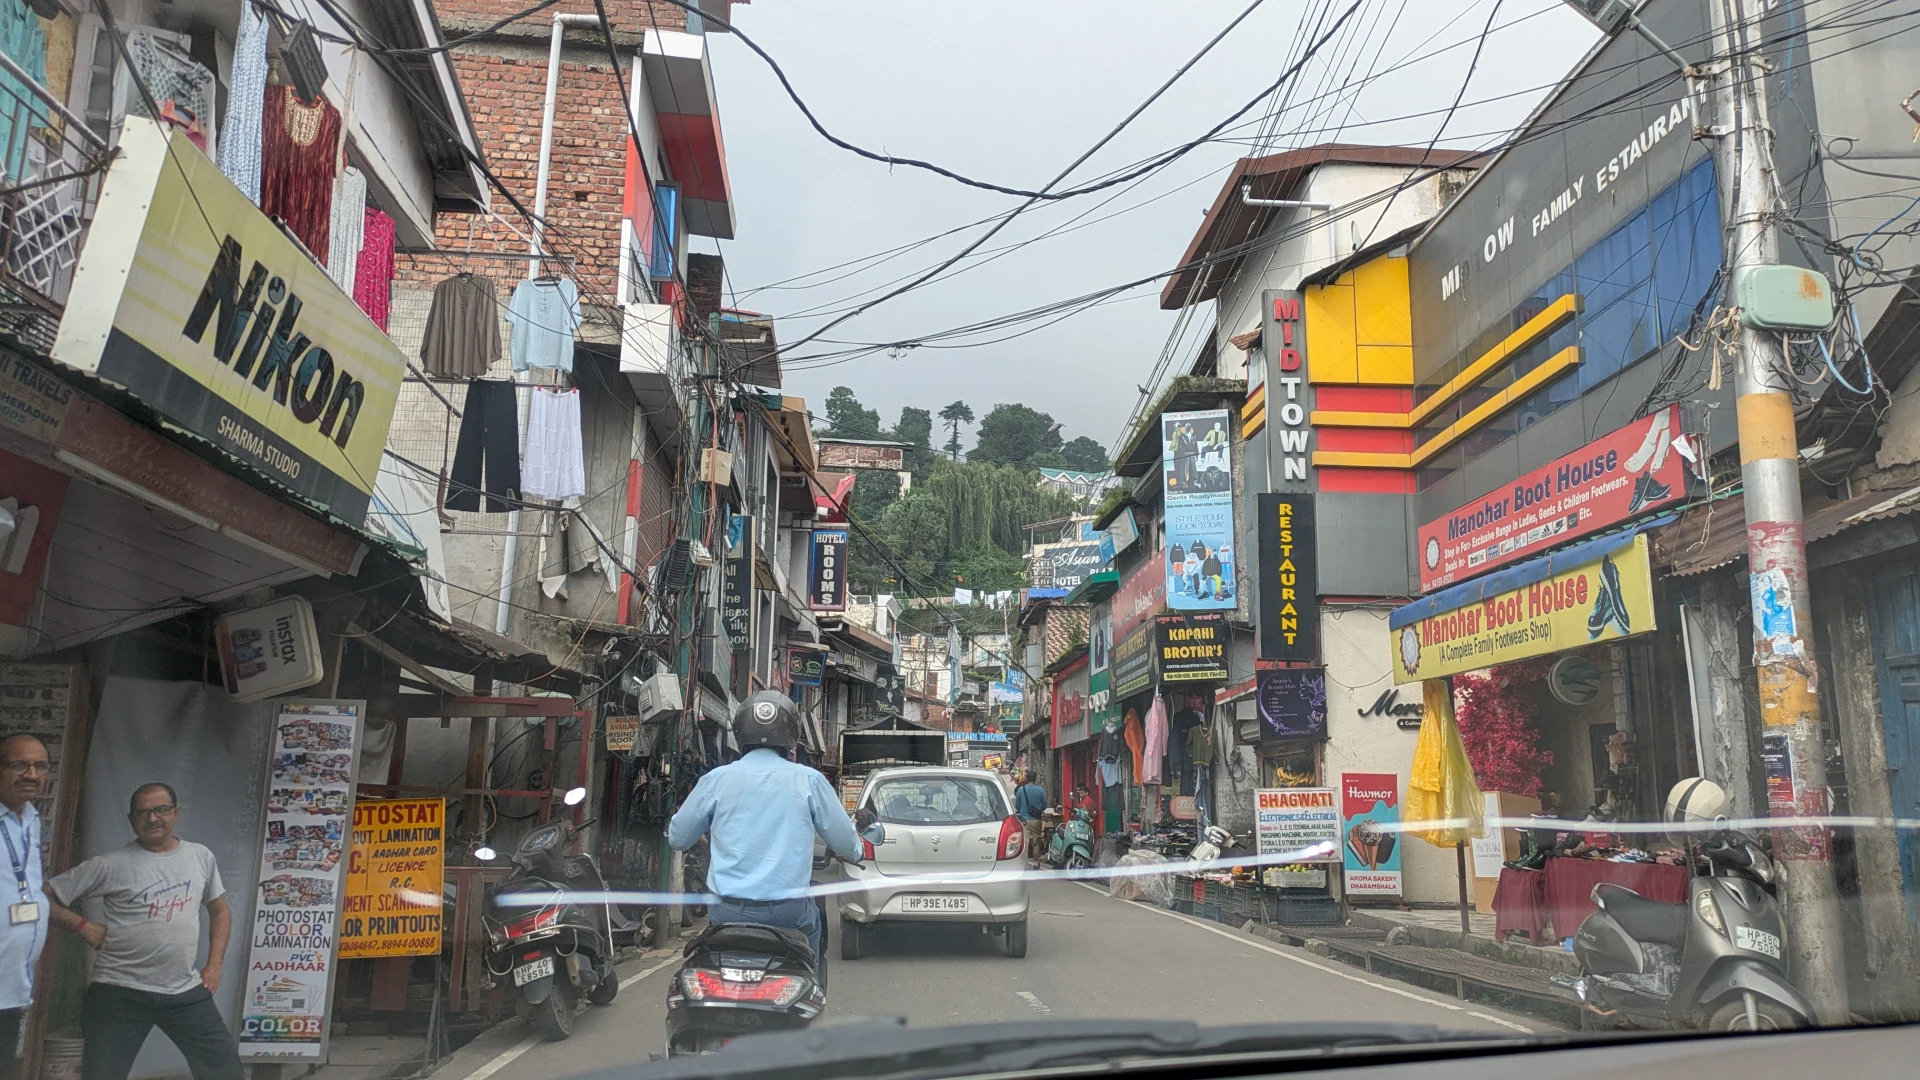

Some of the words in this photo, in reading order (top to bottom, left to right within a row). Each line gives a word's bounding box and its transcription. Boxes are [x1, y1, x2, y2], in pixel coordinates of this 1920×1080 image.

[1532, 174, 1585, 238] FAMILY
[182, 233, 365, 450] Nikon
[11, 361, 73, 406] TRAVELS
[0, 391, 59, 428] HERADUN
[217, 415, 264, 460] SHARMA
[263, 445, 300, 479] STUDIO
[1447, 497, 1509, 542] Manohar
[1513, 477, 1551, 512] Boot
[1556, 449, 1618, 495] House
[1176, 515, 1201, 523] STYLE
[1202, 513, 1225, 522] YOUR
[1444, 548, 1455, 560] Step
[1471, 530, 1495, 547] Exclusive
[1495, 524, 1512, 539] Range
[1518, 513, 1538, 528] Ladies,
[1538, 505, 1556, 520] Gents
[1557, 503, 1563, 512] &
[1563, 491, 1590, 511] Children
[1590, 476, 1629, 500] Footwears.
[1579, 507, 1593, 521] Etc.
[1176, 522, 1198, 531] LOOK
[1200, 520, 1225, 529] TODAY
[815, 533, 845, 544] HOTEL
[1052, 548, 1101, 567] Asian
[1445, 560, 1457, 572] Deals
[820, 544, 836, 604] ROOMS
[1279, 503, 1298, 645] RESTAURANT
[1422, 606, 1482, 648] Manohar
[1486, 592, 1523, 631] Boot
[1528, 574, 1588, 620] House
[276, 615, 297, 666] instax
[1168, 627, 1215, 641] KAPAHI
[1445, 637, 1474, 663] Complete
[1474, 633, 1494, 658] Family
[1495, 626, 1529, 652] Footwears
[1530, 617, 1553, 643] Shop)
[1347, 786, 1393, 799] Havmor
[1259, 793, 1335, 809] BHAGWATI
[380, 827, 440, 844] LAMINATION
[372, 848, 410, 859] AADHAR
[412, 846, 438, 857] CARD
[378, 861, 427, 873] LICENCE
[389, 877, 415, 888] R.C.
[909, 899, 922, 909] HP
[923, 899, 941, 909] 39E
[942, 899, 966, 909] 1485
[257, 910, 334, 924] PHOTOSTAT
[264, 923, 323, 936] COLOR
[368, 914, 440, 936] PRINTOUTS
[254, 936, 332, 949] LAMINATION
[1750, 940, 1775, 956] 7506
[290, 954, 315, 962] PVC
[252, 961, 326, 972] AADHAAR
[521, 965, 533, 975] HP
[537, 960, 549, 969] 40
[521, 966, 550, 984] E8594
[244, 1019, 321, 1033] COLOR
